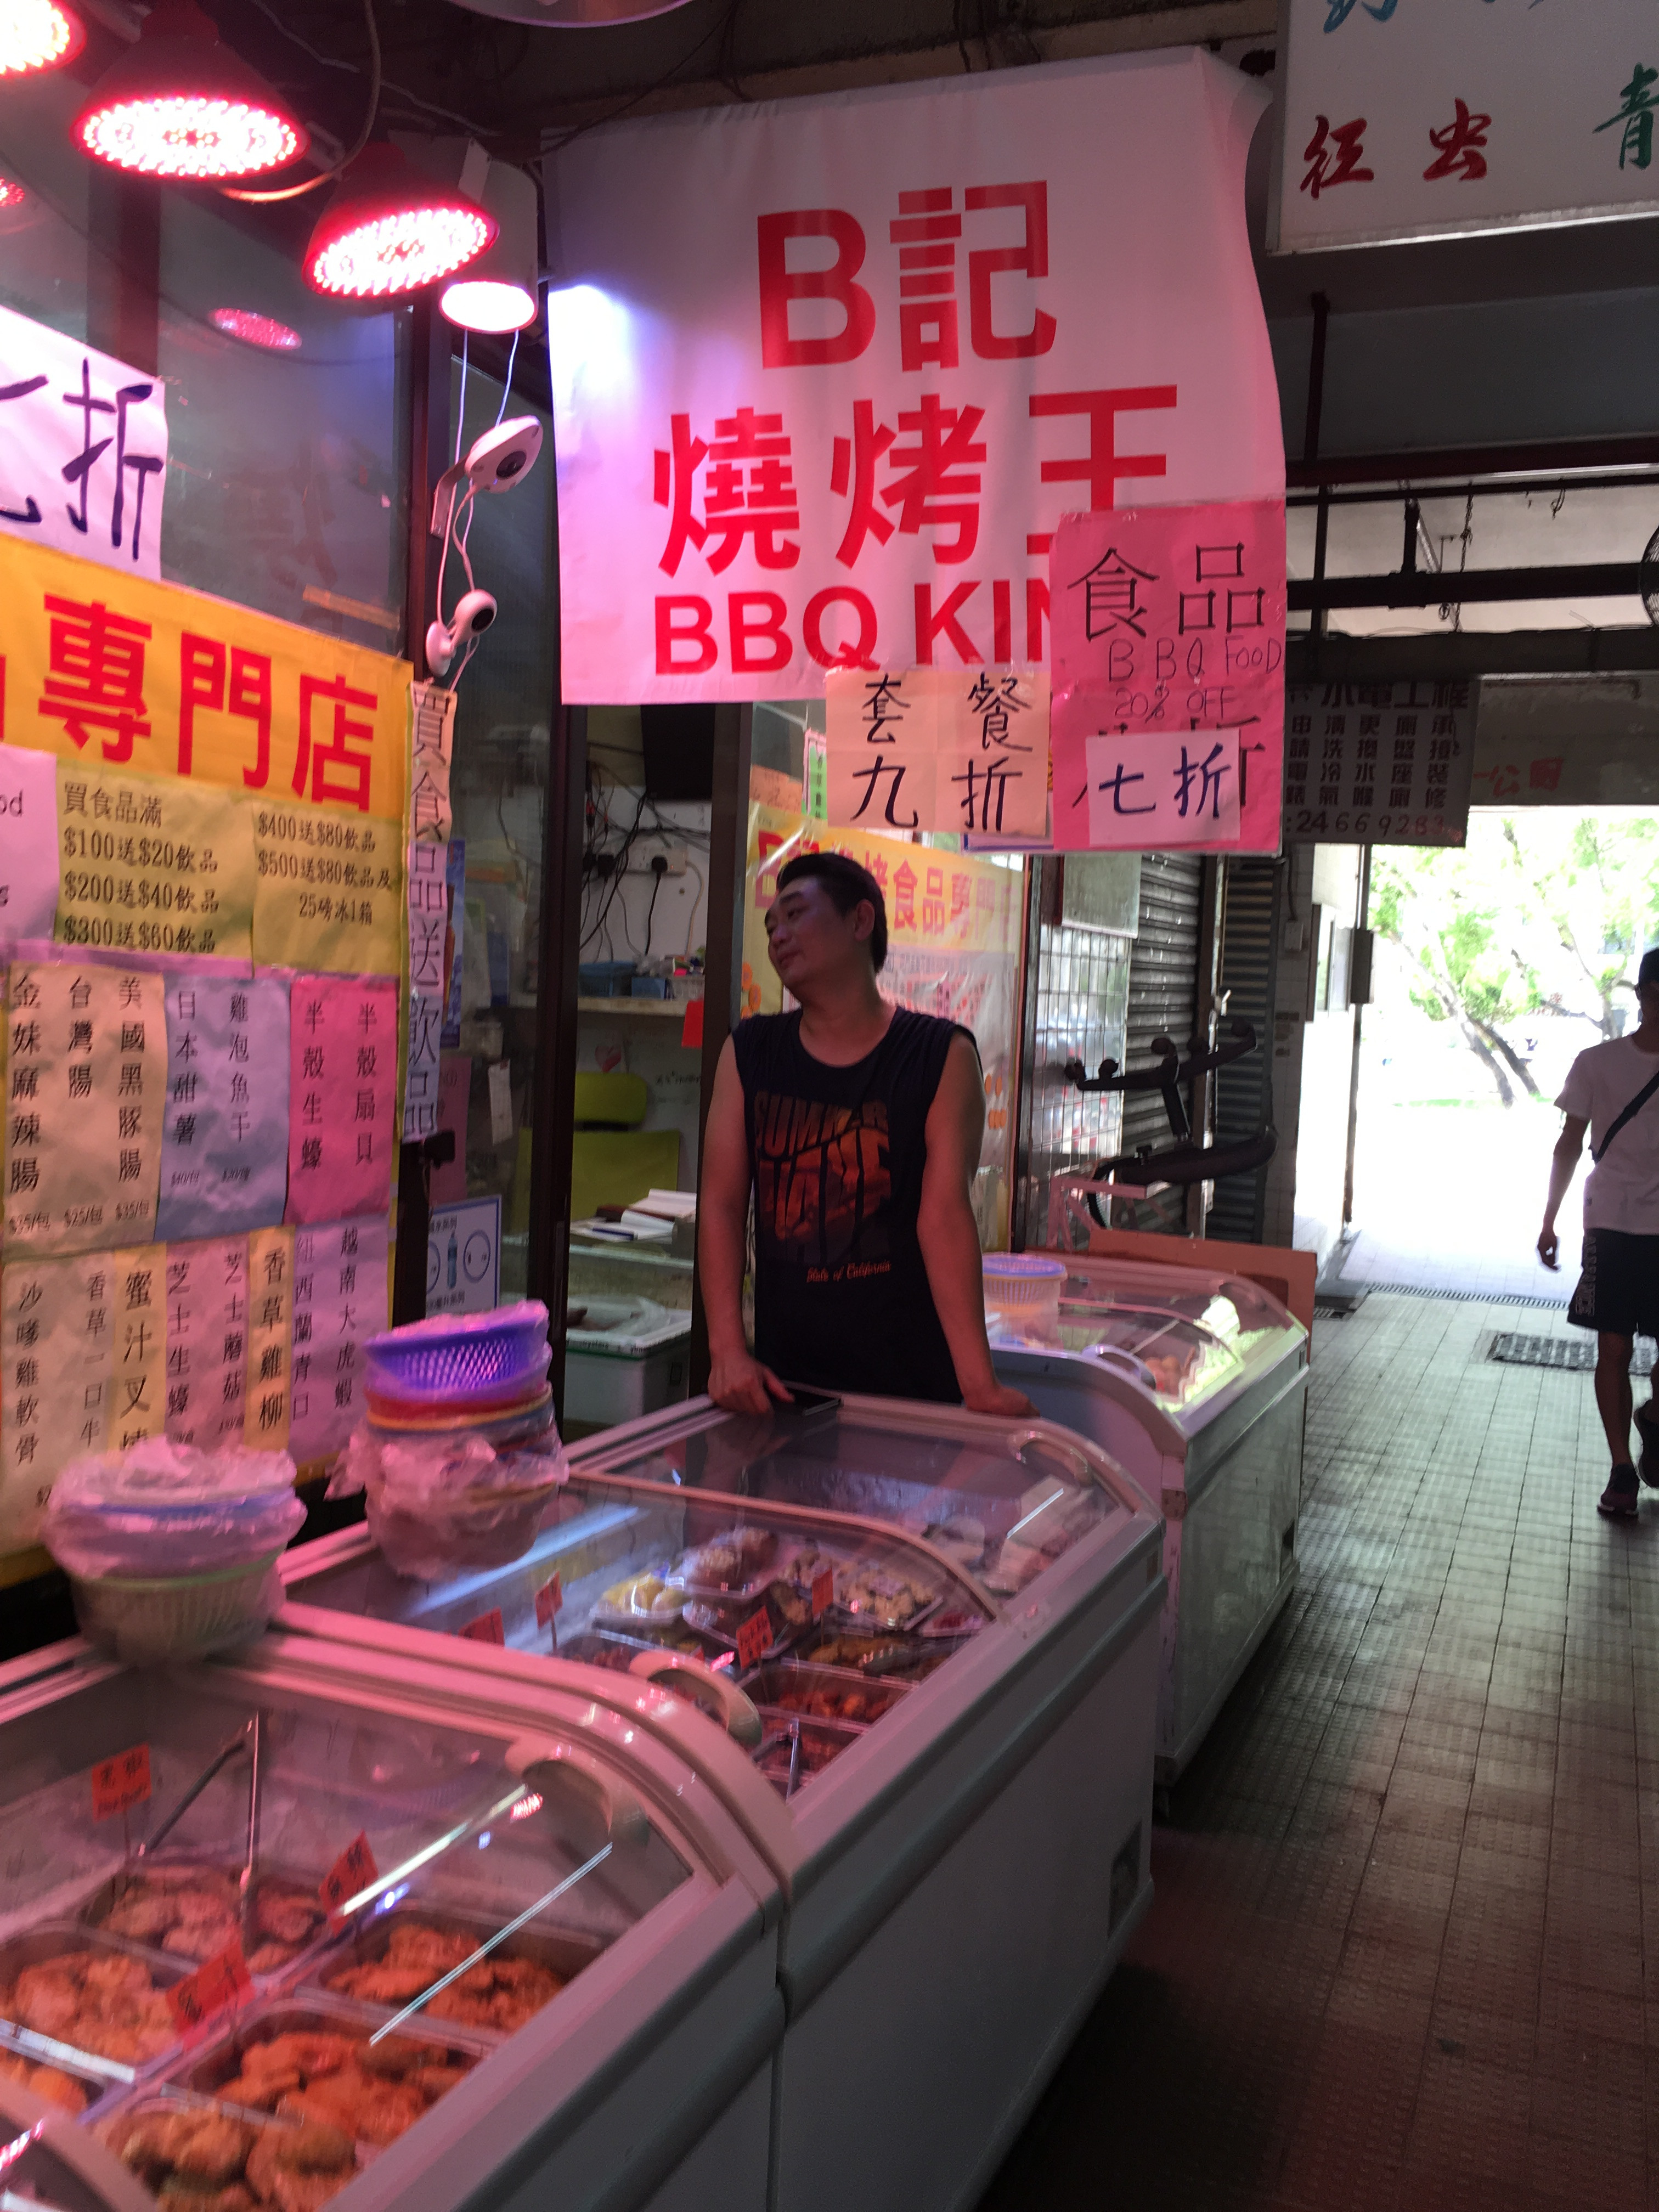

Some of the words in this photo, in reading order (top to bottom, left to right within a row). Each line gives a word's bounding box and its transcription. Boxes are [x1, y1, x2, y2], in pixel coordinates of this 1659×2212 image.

[757, 180, 1056, 373] B記
[653, 385, 1177, 578] 燒烤王
[654, 586, 879, 675] BBQ
[1068, 542, 1266, 641] 食品
[0, 592, 377, 812] 專門店
[862, 673, 1032, 752] 套餐
[1115, 686, 1170, 724] 20%
[1187, 686, 1235, 719] OFF
[63, 780, 162, 829] 買食品滿
[850, 755, 1023, 832] 九折
[1098, 742, 1232, 820] 七折
[64, 826, 218, 873] $100送$20飲品
[64, 870, 219, 914] $200送$40飲品
[301, 1000, 325, 1170] 半殼生蠔
[258, 1247, 285, 1432] 香草雞柳
